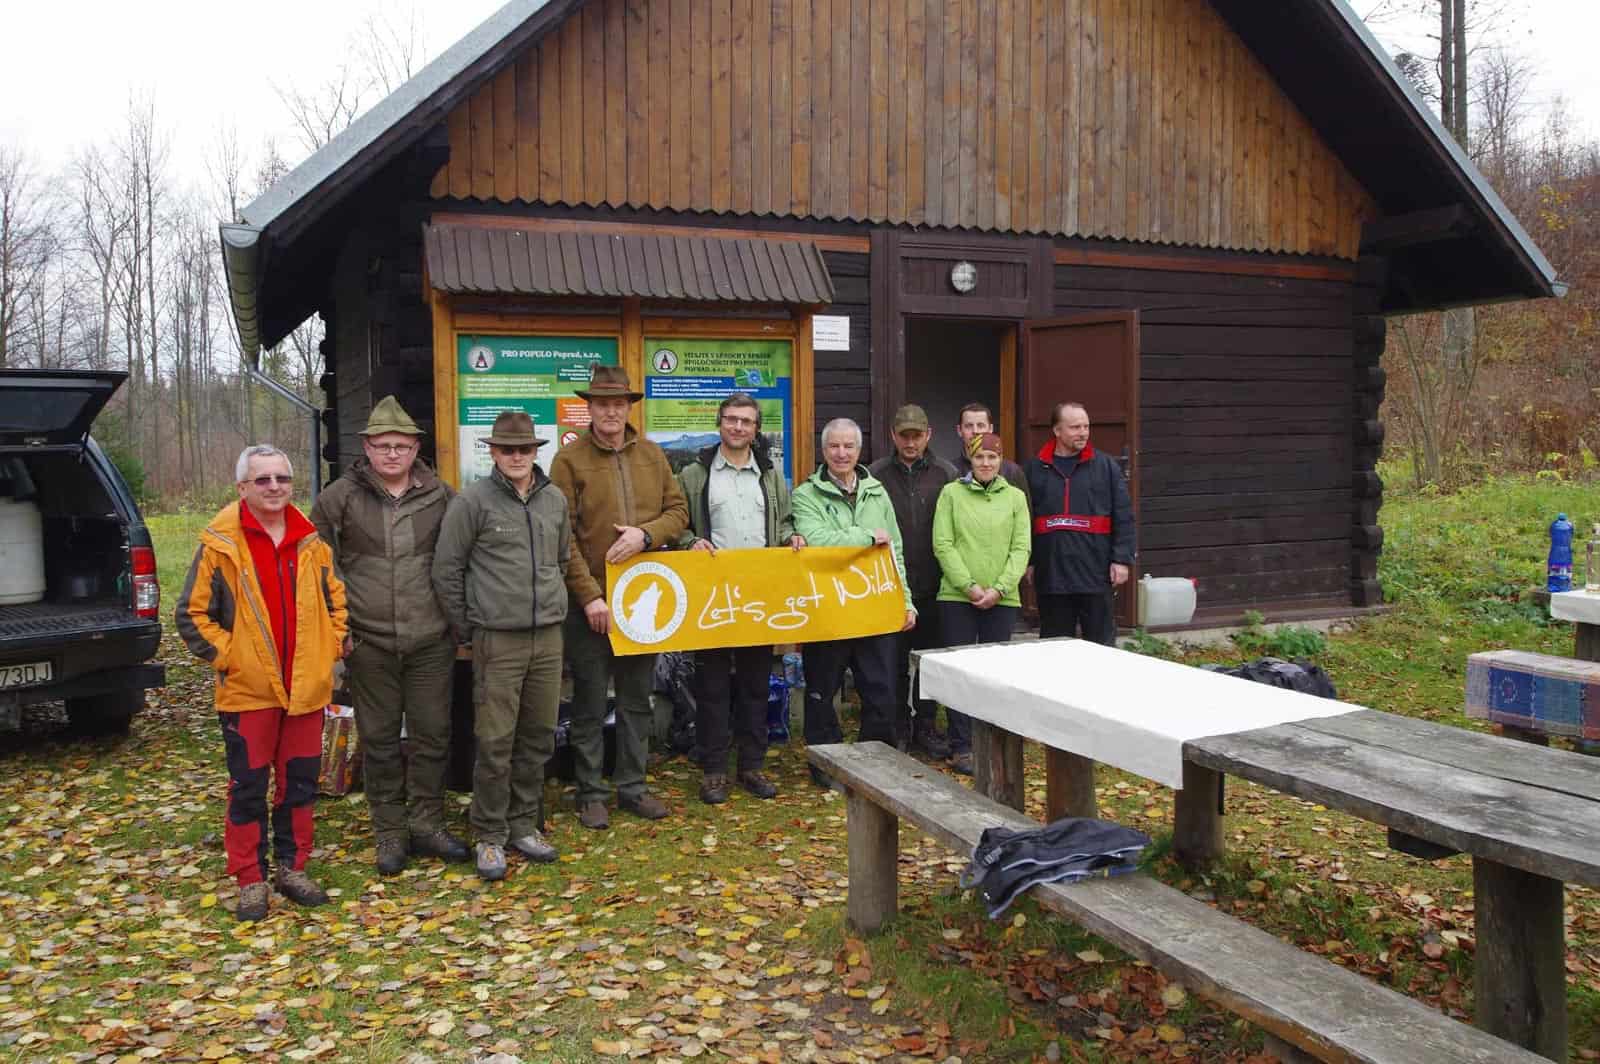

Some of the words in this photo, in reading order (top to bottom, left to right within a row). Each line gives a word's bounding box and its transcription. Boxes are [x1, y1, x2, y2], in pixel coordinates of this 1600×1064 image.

[501, 350, 518, 358] PRO
[519, 350, 552, 358] POPULO
[697, 583, 766, 630] Let's
[767, 571, 824, 630] get
[832, 554, 898, 607] Wild!
